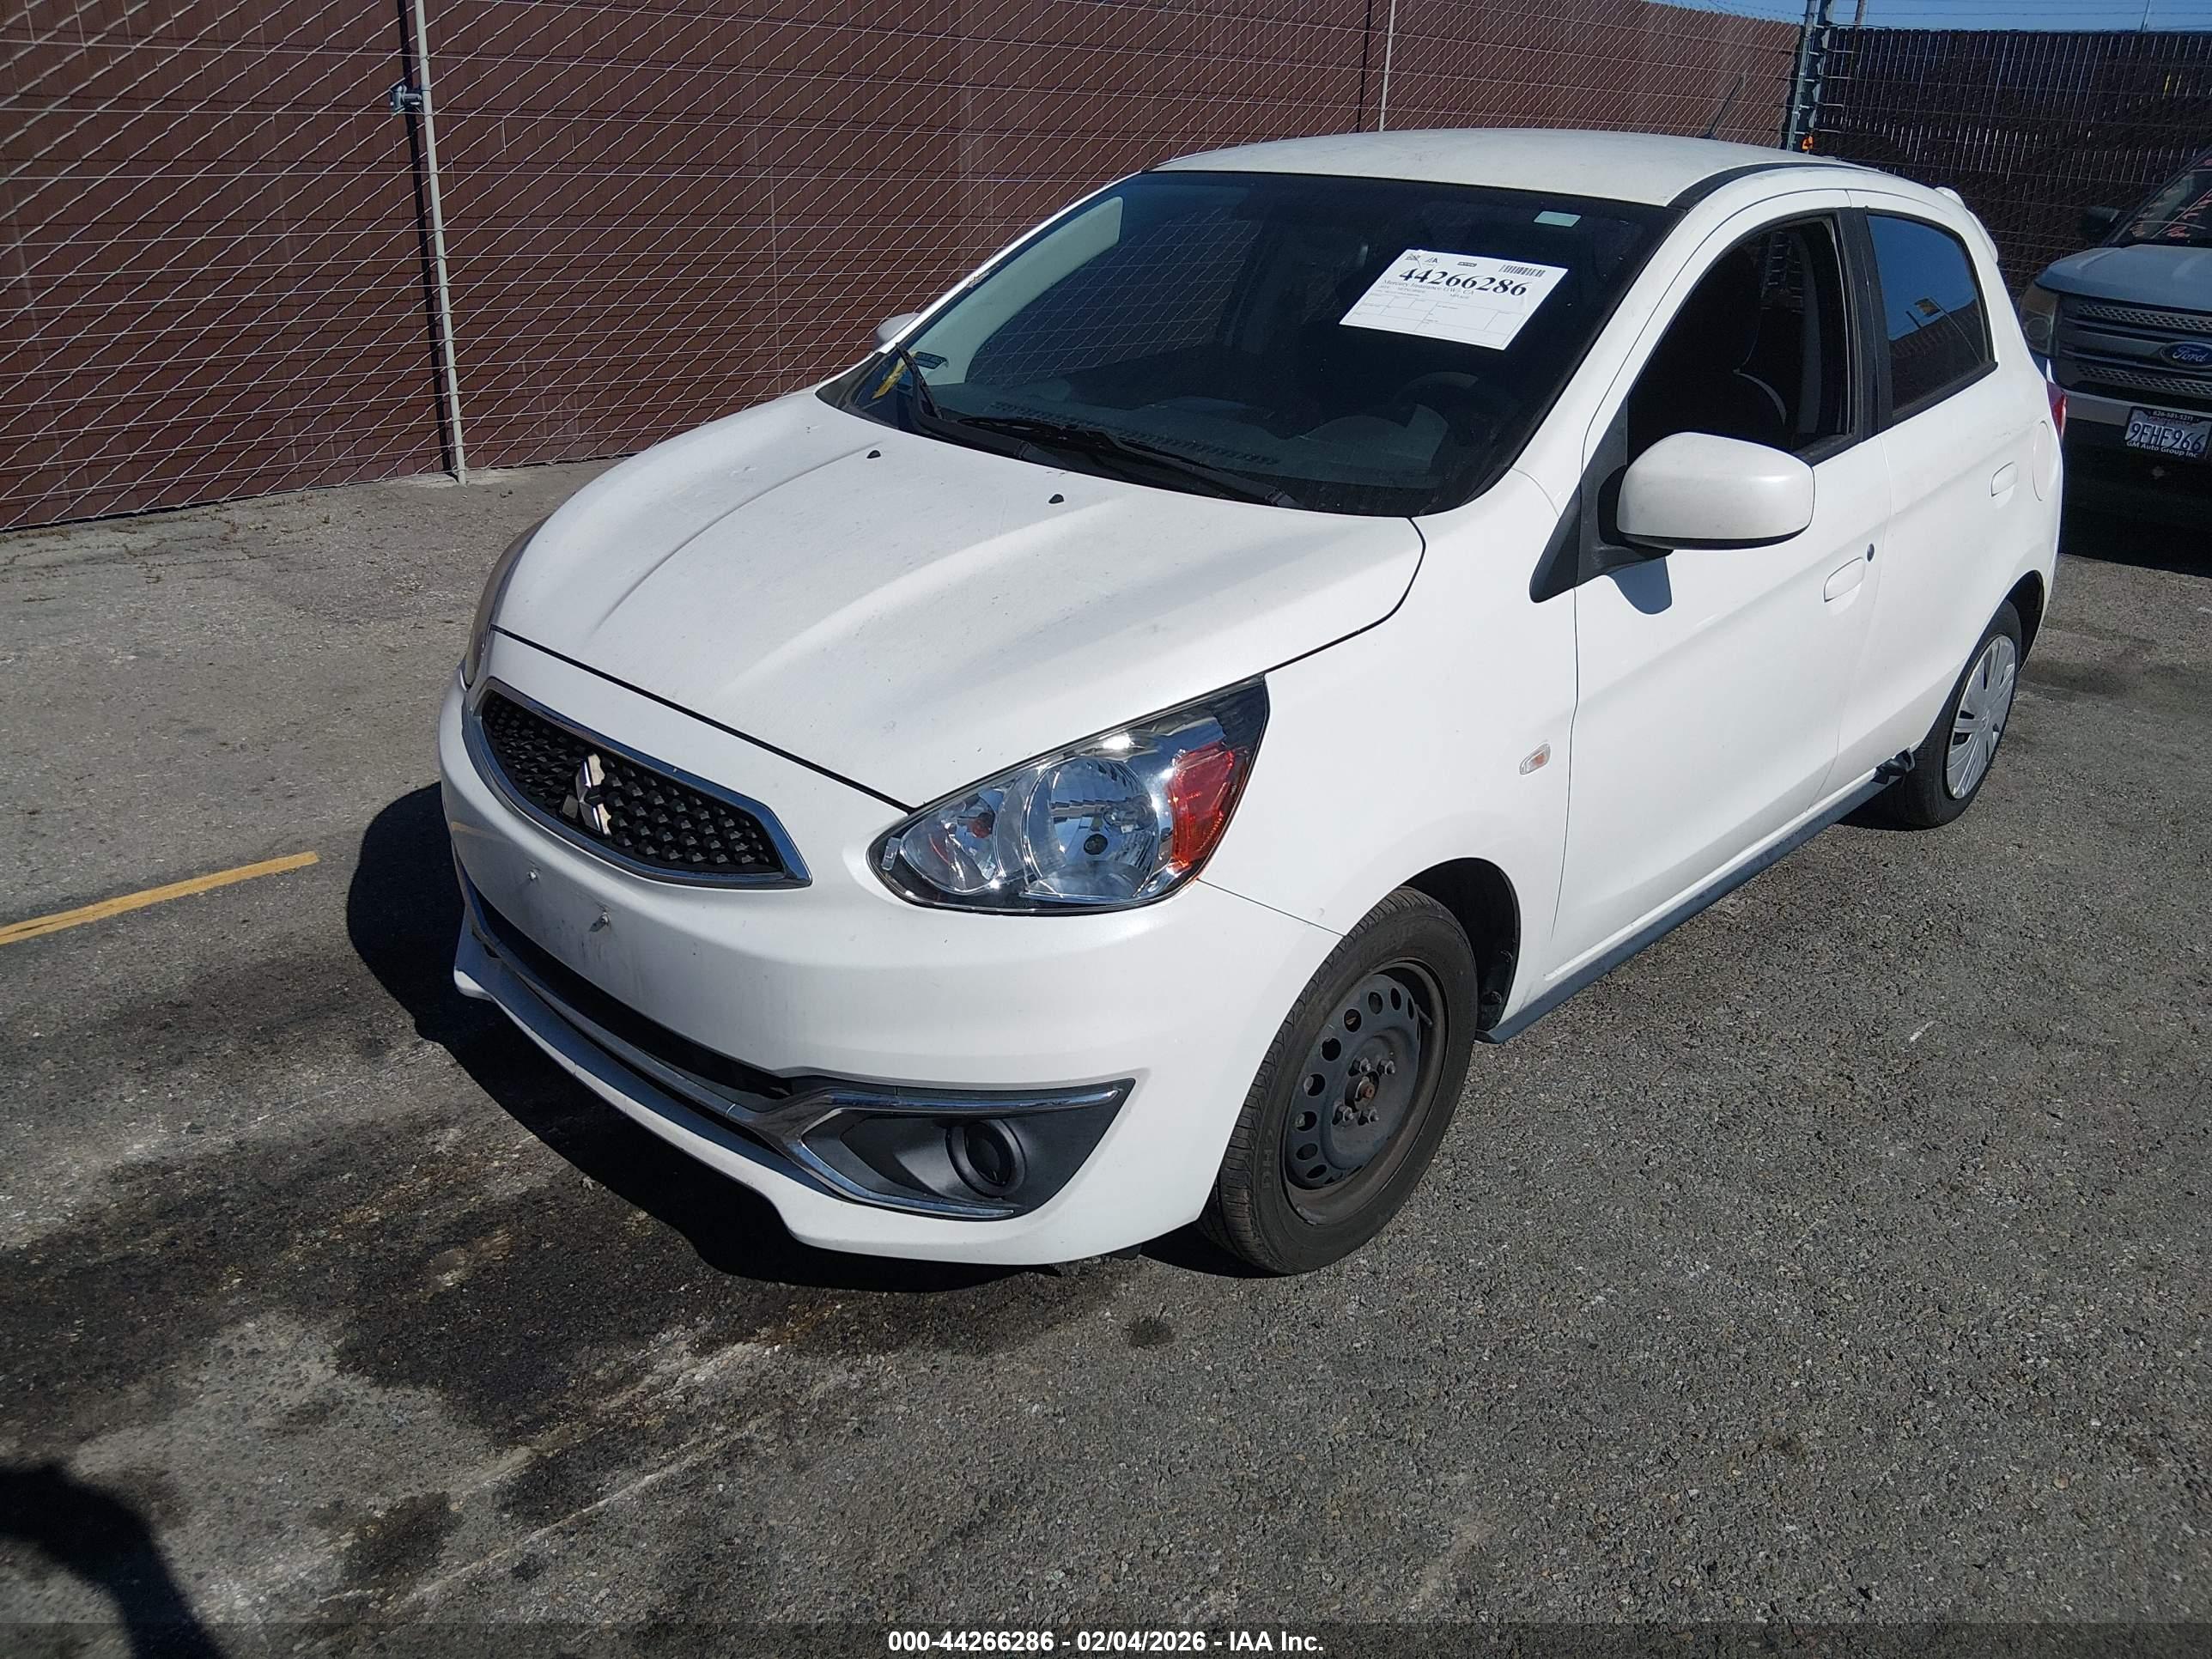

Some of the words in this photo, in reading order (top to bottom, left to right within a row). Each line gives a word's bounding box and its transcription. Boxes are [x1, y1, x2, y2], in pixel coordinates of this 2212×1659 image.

[1399, 268, 1531, 296] 44266286
[2172, 345, 2208, 362] Ford
[2126, 441, 2140, 449] GM
[2141, 443, 2160, 452] Auto
[2160, 447, 2185, 457] Group
